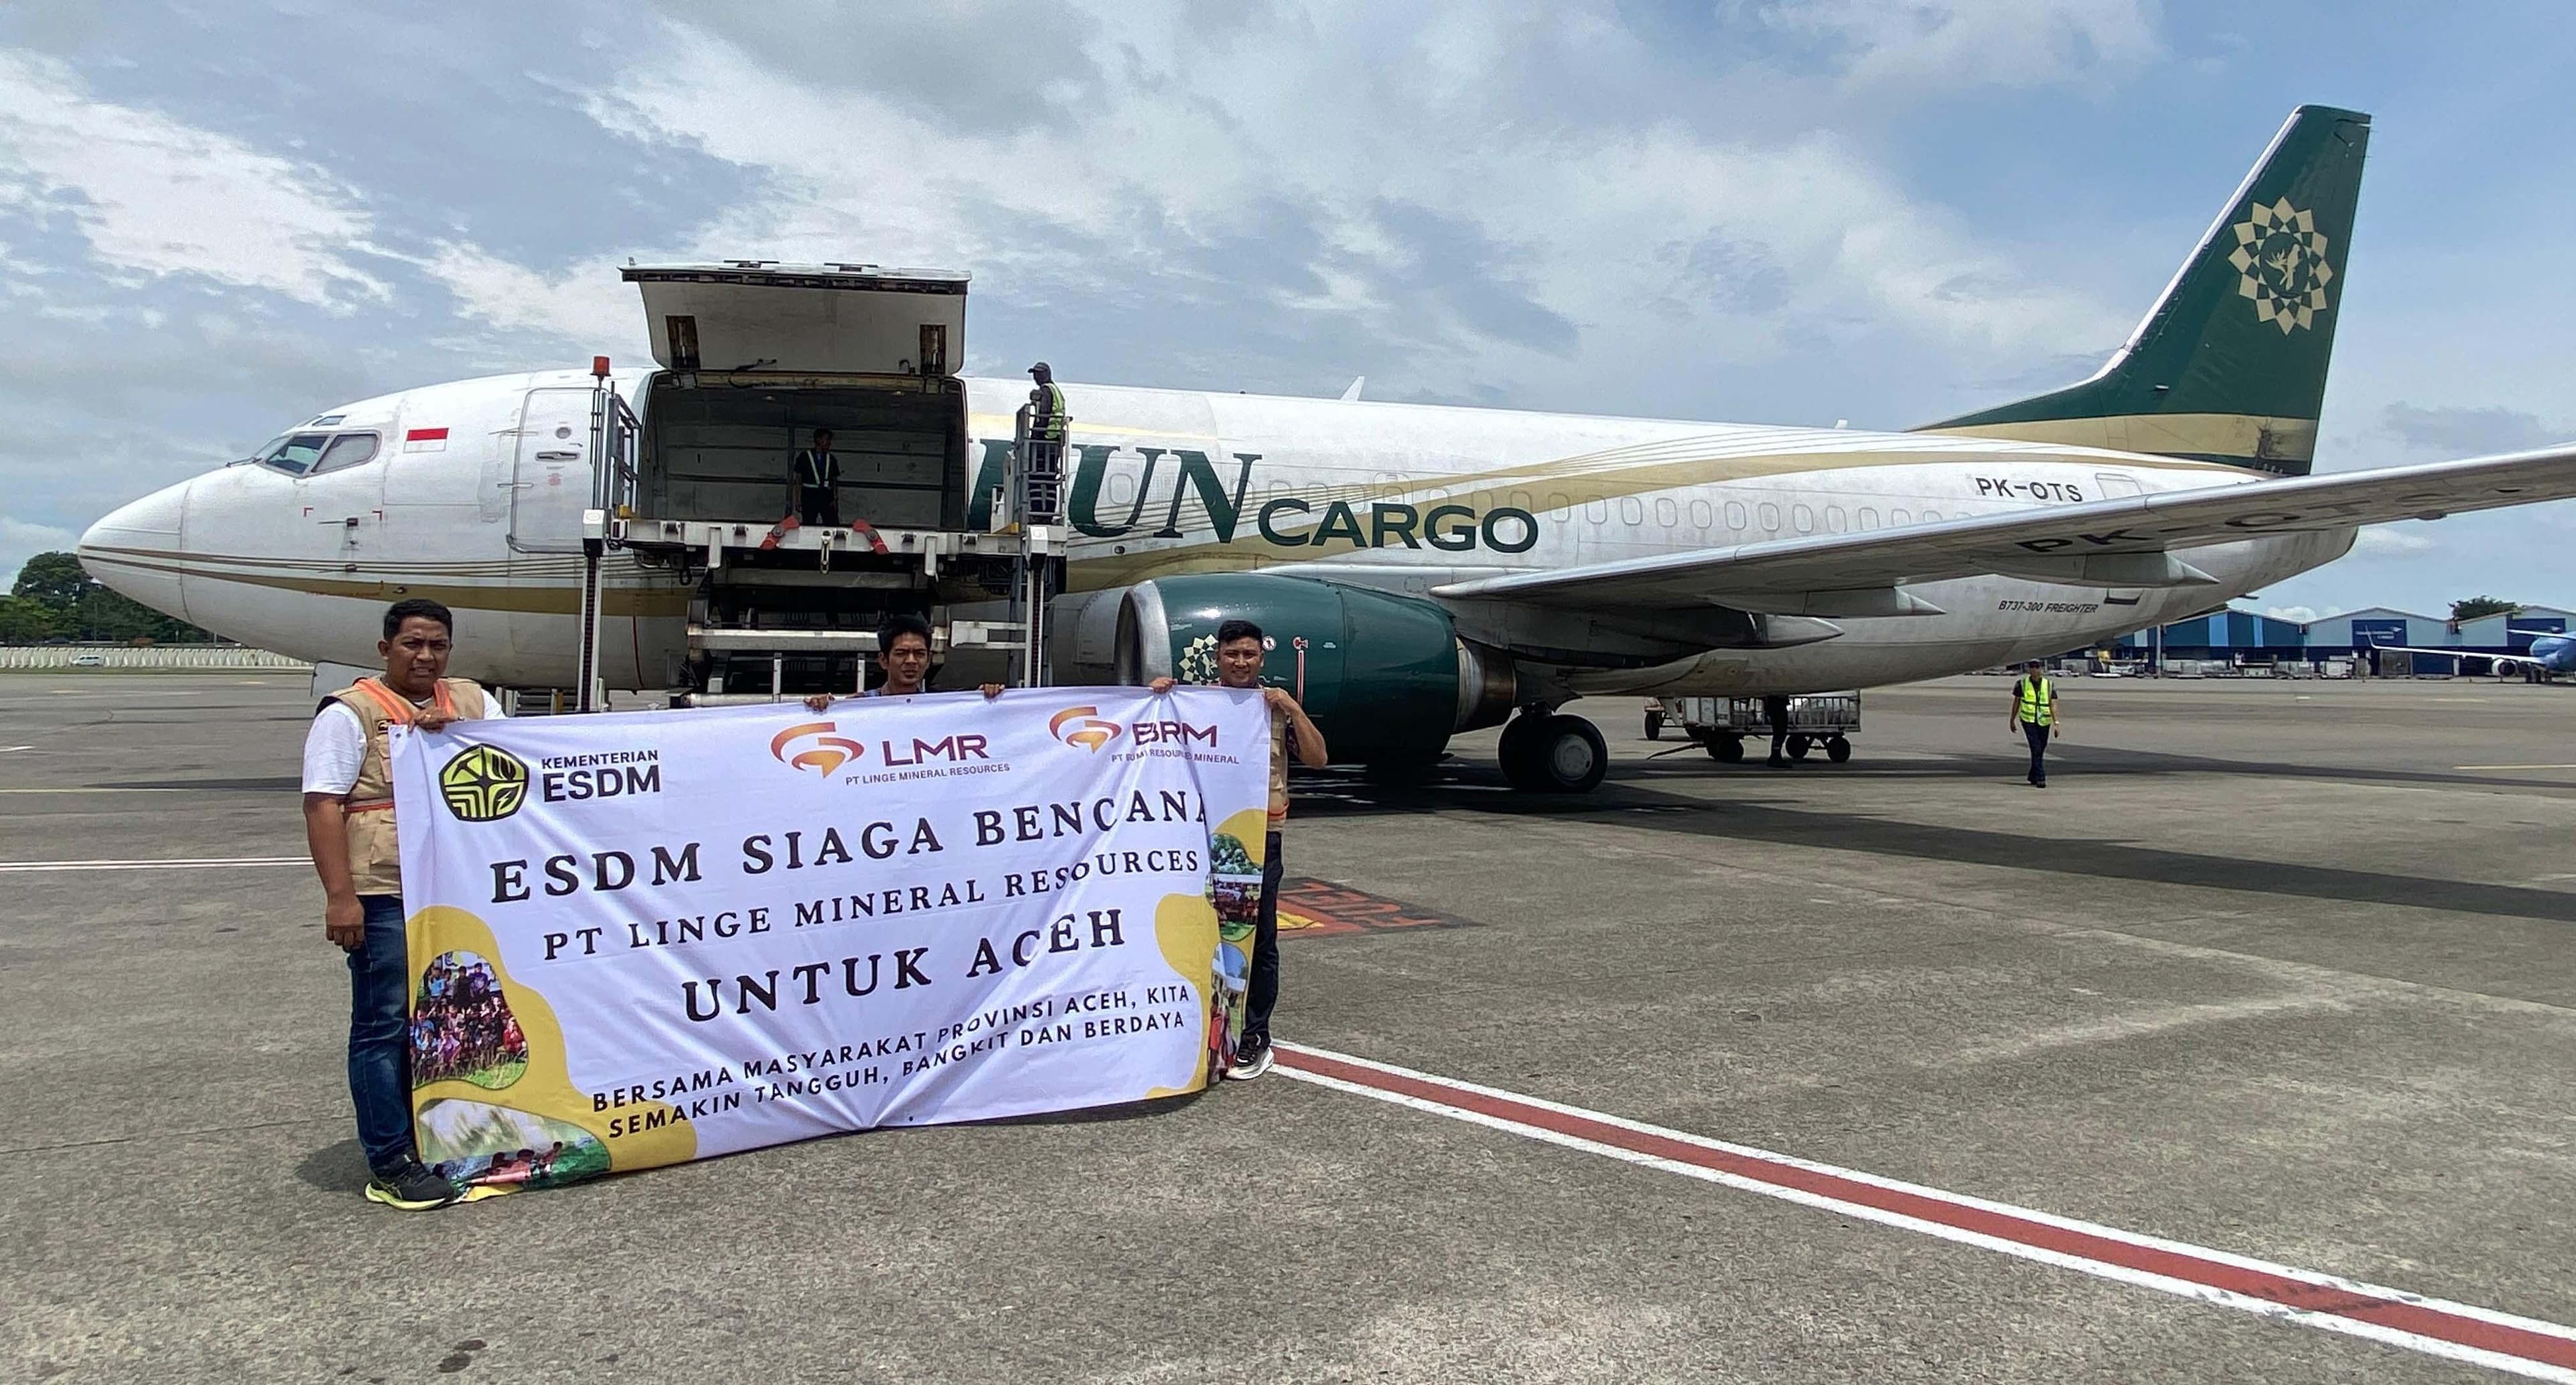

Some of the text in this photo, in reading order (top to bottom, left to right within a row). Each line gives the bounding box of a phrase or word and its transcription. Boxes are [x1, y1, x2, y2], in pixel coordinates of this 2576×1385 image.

[1976, 478, 2083, 502] PK-OTS
[1258, 498, 1538, 553] CARGO
[1998, 600, 2098, 613] B737-300 FREIGHTER
[882, 734, 990, 767] LMR
[1132, 721, 1217, 747] BRM
[541, 749, 659, 769] KEMENTERIAN
[845, 763, 1010, 785] PT LINGE MINERAL RESOURCES
[1112, 754, 1122, 762] PT
[1194, 753, 1239, 764] MINERAL
[543, 765, 661, 802] ESDM
[490, 842, 702, 903] ESDM
[742, 818, 943, 874] SIAGA
[544, 850, 1199, 960] PT LINGE MINERAL RESOURCES
[682, 908, 1125, 1023] UNTUK ACEH
[593, 985, 1189, 1113] BERSAMA MASYARAKAT PROVINSI ACEH, KITA
[609, 1011, 1184, 1138] SEMAKIN TANGGUH, BANGKIT DAN BERDAYA
